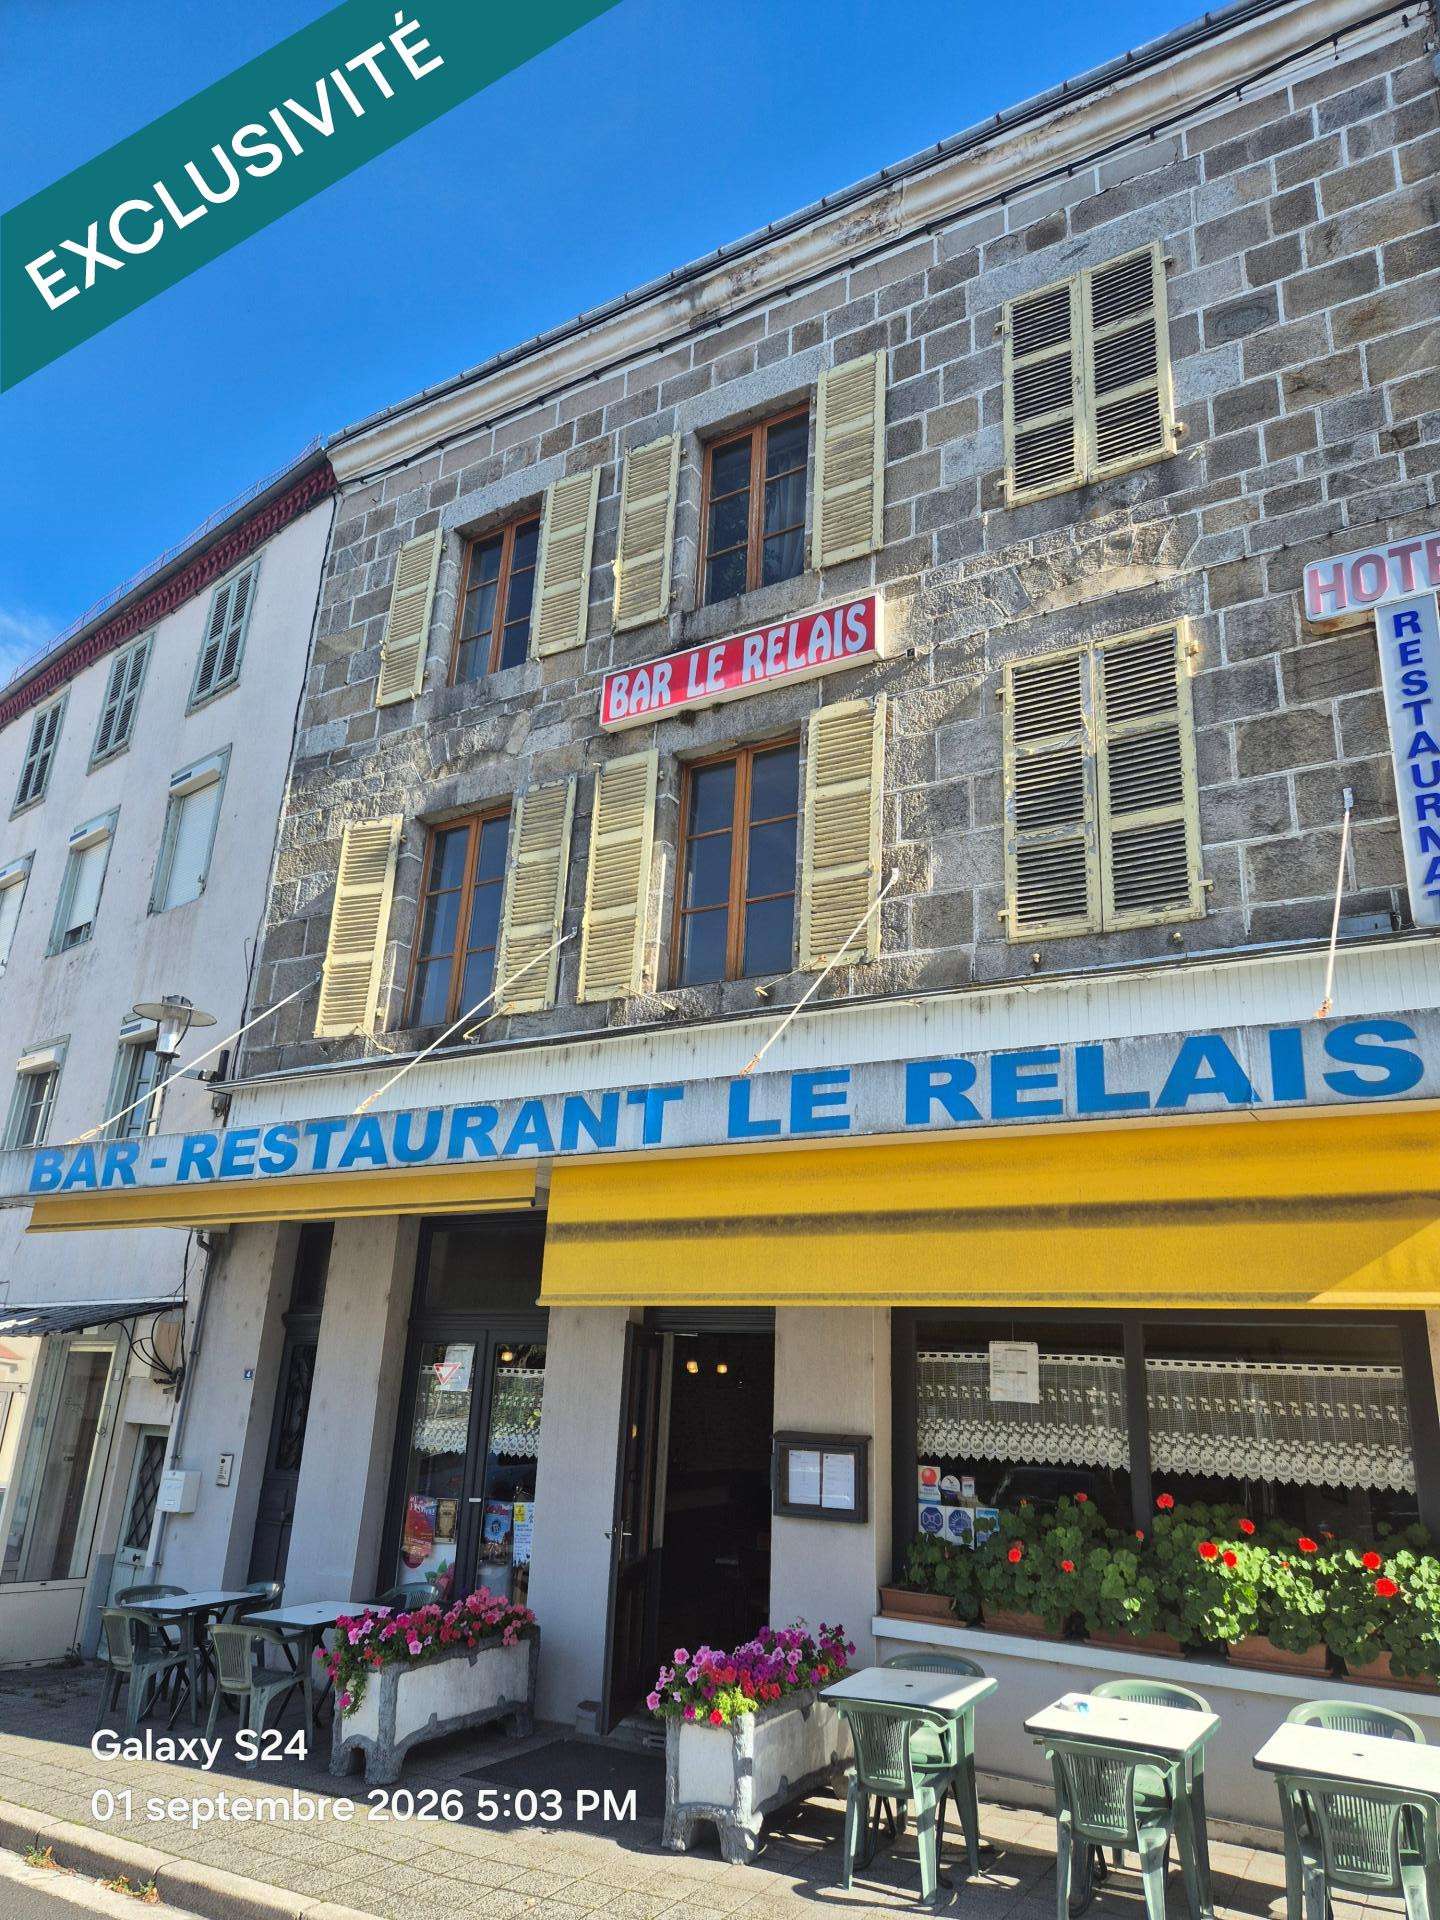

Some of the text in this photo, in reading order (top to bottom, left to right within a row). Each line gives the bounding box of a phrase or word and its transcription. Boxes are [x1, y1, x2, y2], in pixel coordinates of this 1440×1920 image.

[609, 603, 868, 719] BAR LE RELAIS
[727, 1067, 853, 1140] LE
[904, 1019, 1425, 1127] RELAIS
